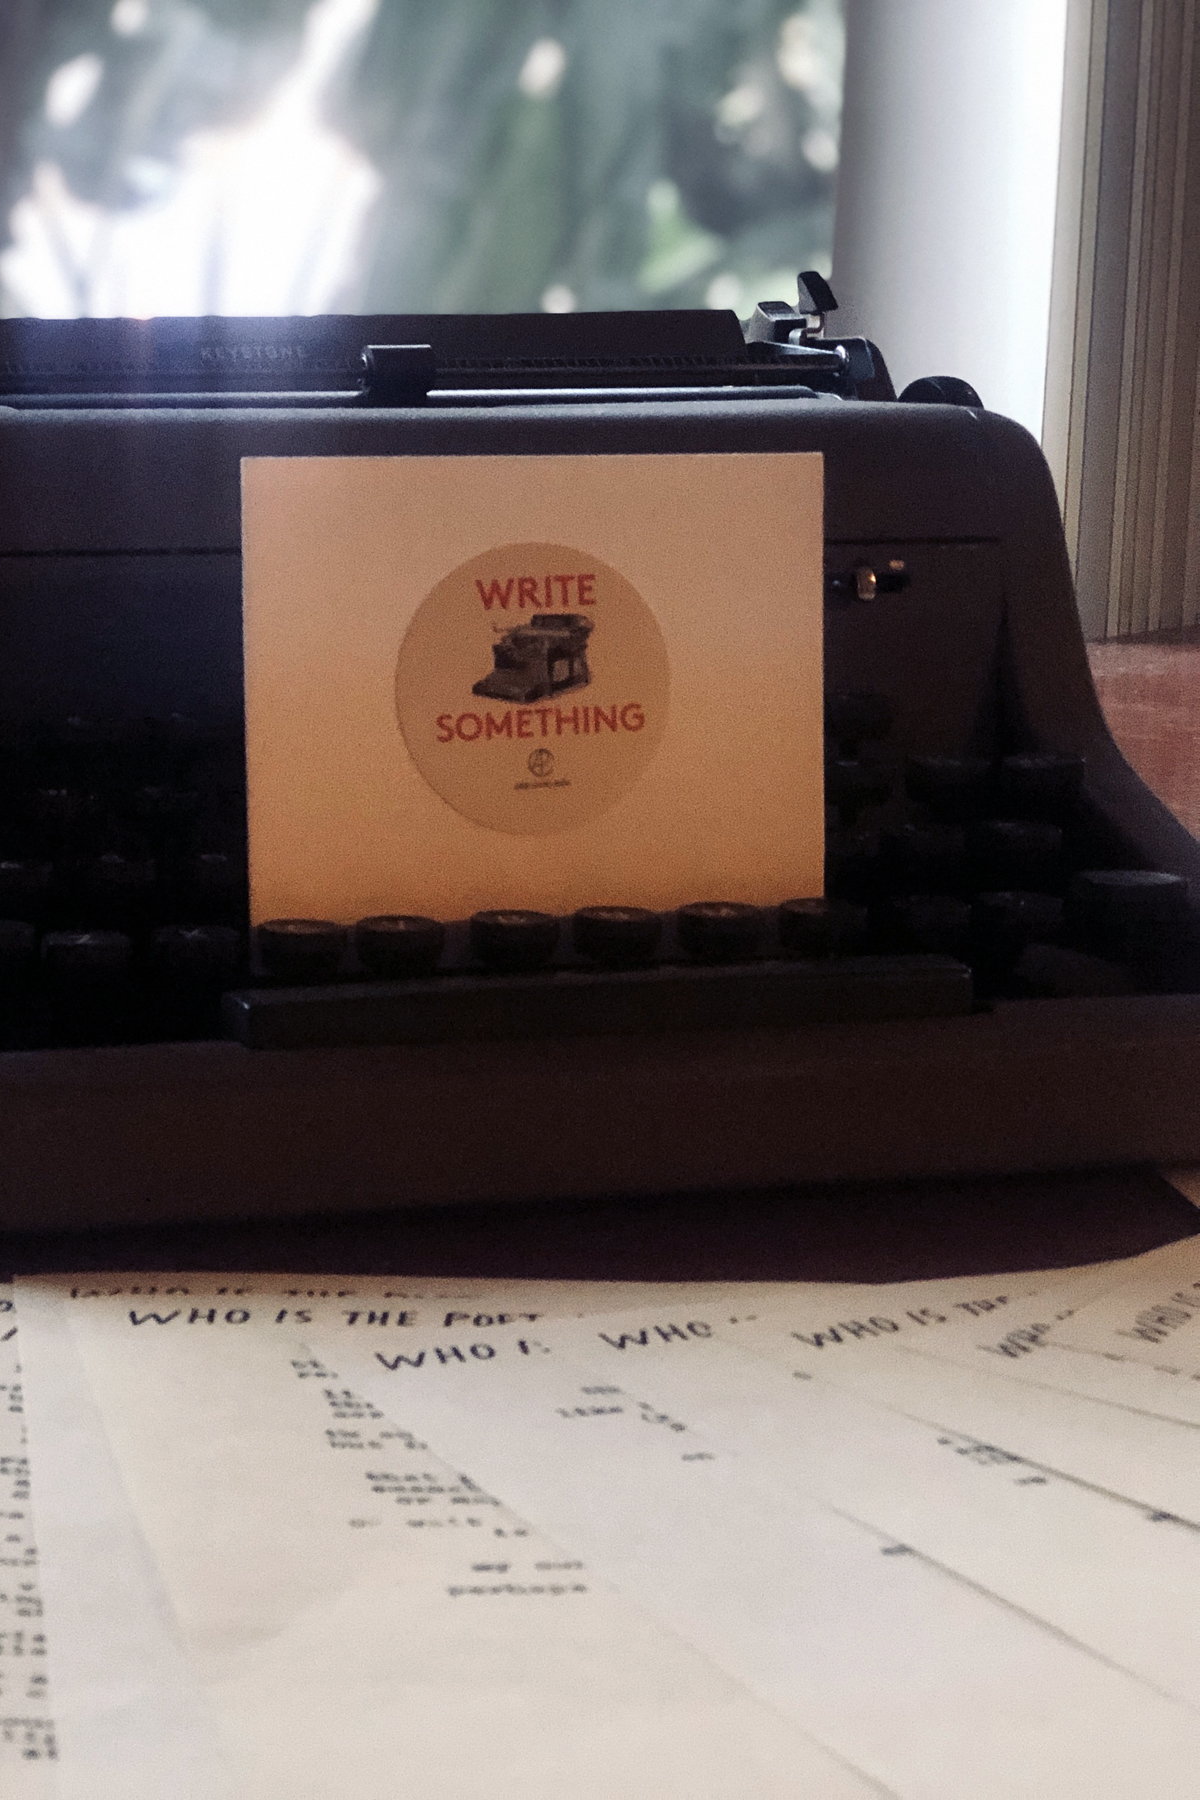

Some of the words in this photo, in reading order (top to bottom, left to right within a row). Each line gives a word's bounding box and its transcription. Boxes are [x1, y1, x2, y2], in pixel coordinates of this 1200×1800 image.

[475, 573, 597, 610] WRITE
[435, 702, 646, 743] SOMETHING
[129, 1308, 251, 1327] WHO
[275, 1308, 314, 1324] IS
[341, 1309, 419, 1328] THE
[791, 1315, 900, 1349] WHO
[597, 1319, 714, 1350] WHO
[374, 1342, 497, 1371] WHO
